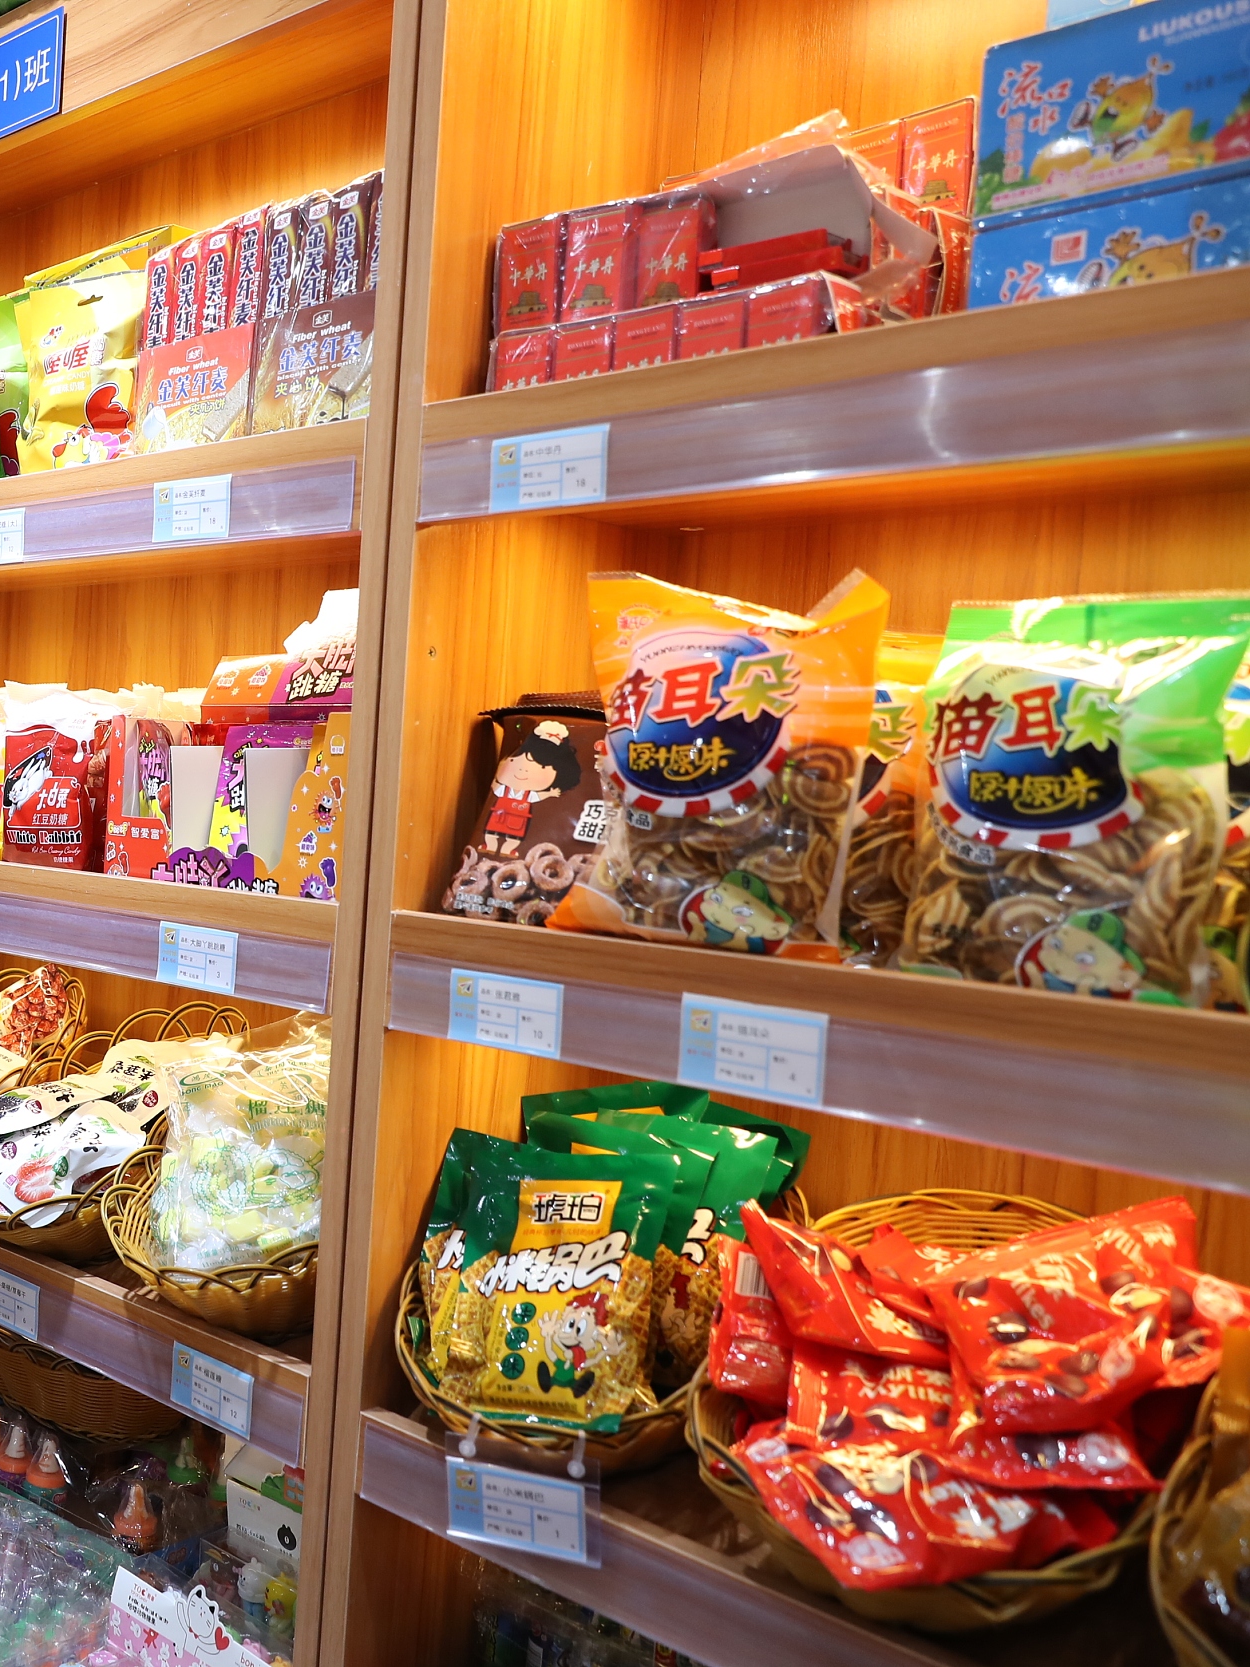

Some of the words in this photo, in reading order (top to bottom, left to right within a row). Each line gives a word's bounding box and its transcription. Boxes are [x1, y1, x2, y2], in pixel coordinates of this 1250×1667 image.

[293, 329, 317, 343] Fiber
[320, 321, 351, 335] wheat
[278, 330, 363, 374] 金芙纤麦
[168, 364, 190, 376] Fiber
[192, 357, 219, 370] wheat
[309, 363, 330, 376] with
[158, 366, 228, 404] 金芙纤麦
[37, 781, 69, 811] 大白兔
[32, 813, 68, 826] 红豆奶糖
[6, 829, 37, 845] White
[39, 828, 82, 845] Rabbit
[216, 971, 221, 979] 3
[533, 1030, 543, 1039] 10
[230, 1409, 237, 1419] 12
